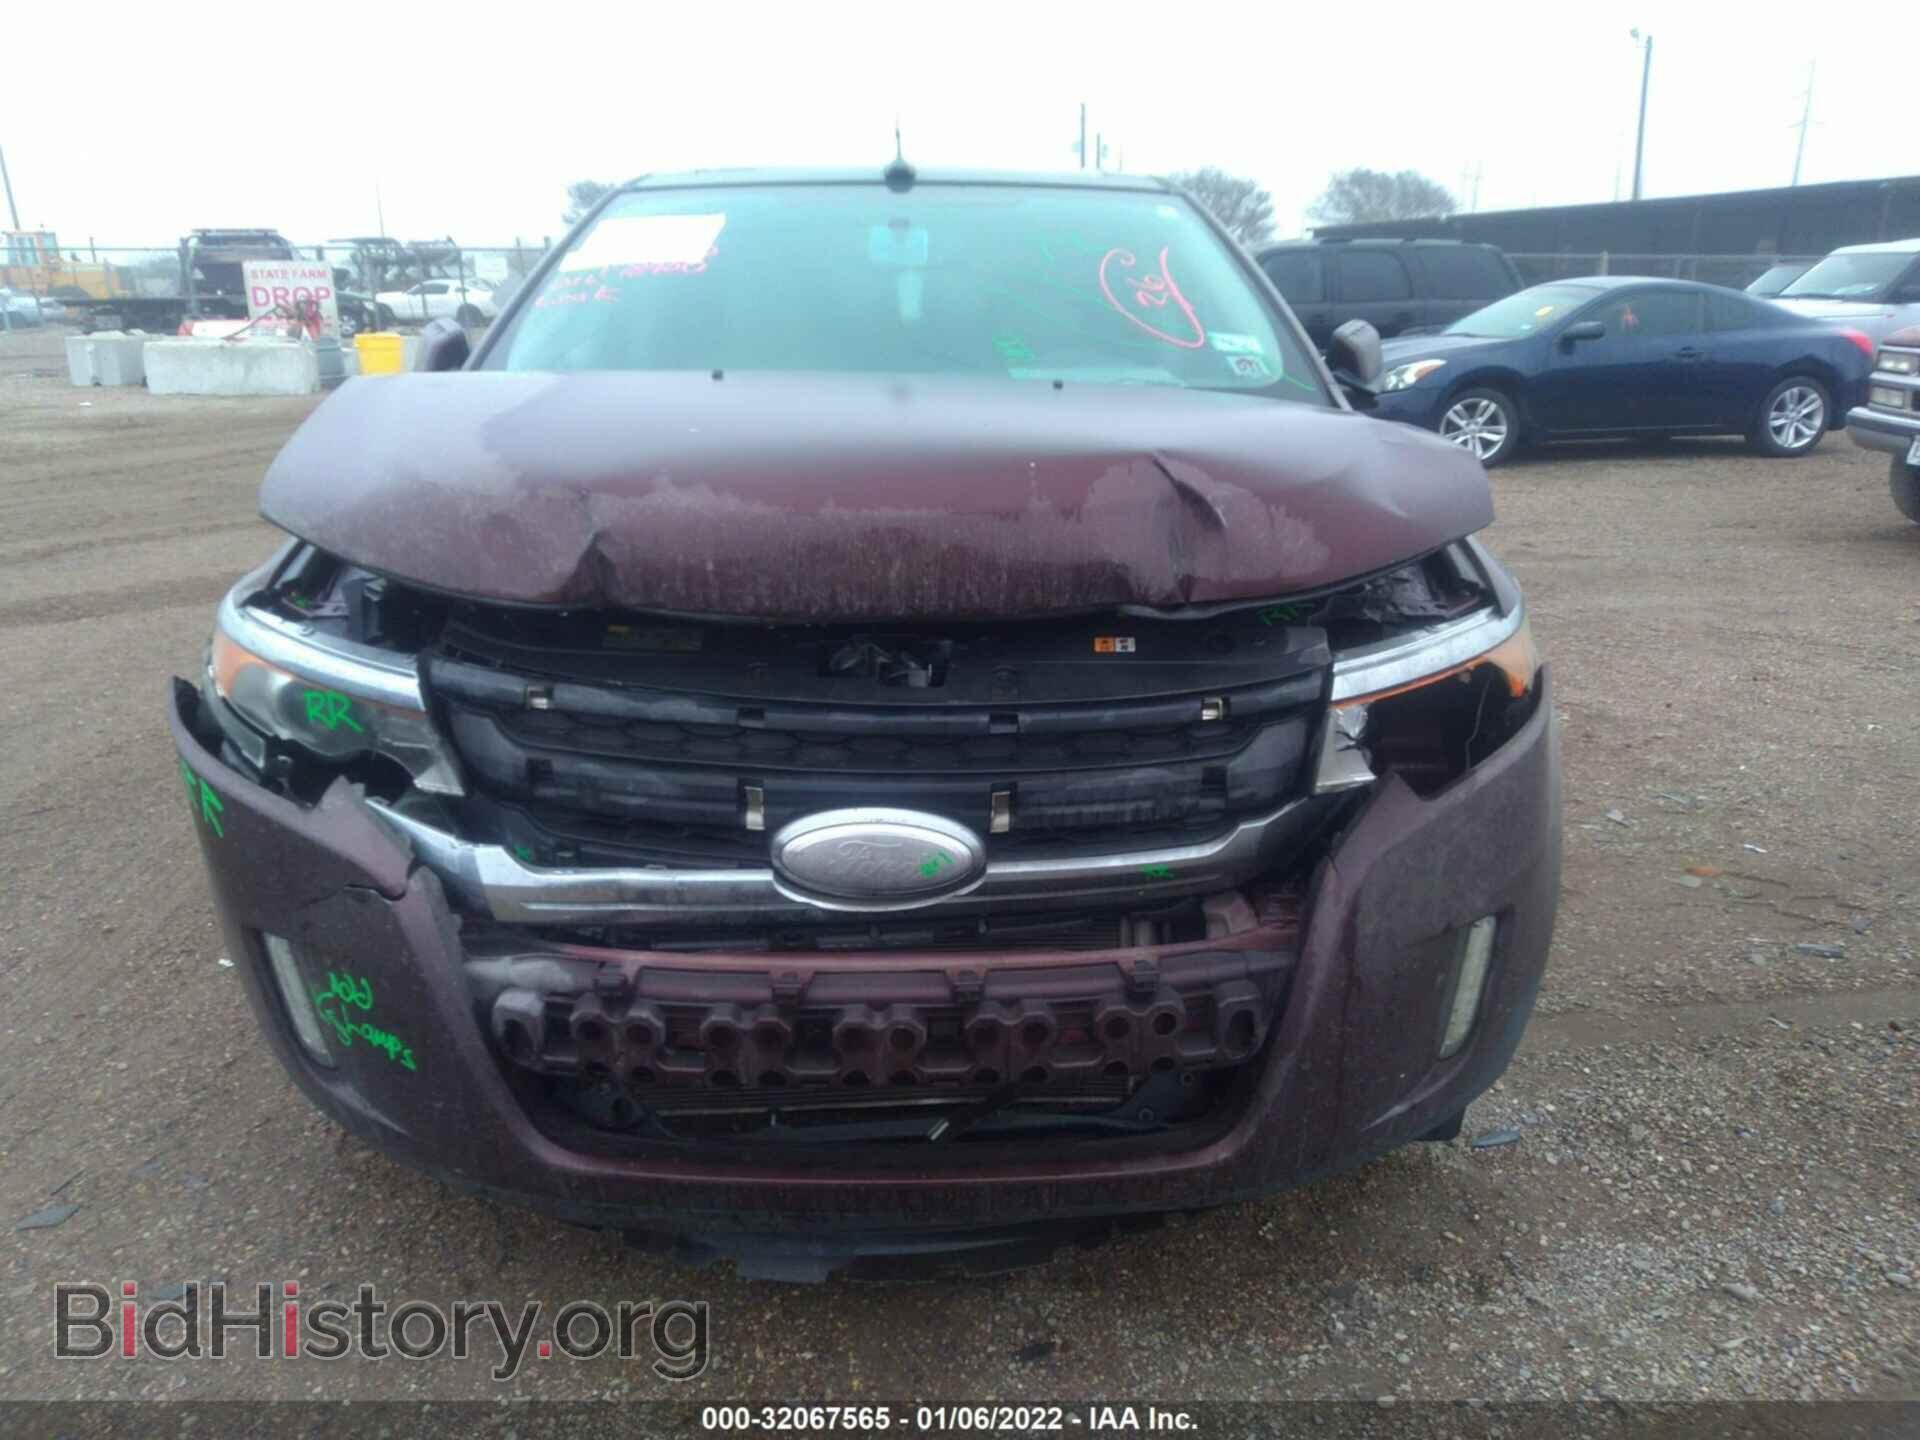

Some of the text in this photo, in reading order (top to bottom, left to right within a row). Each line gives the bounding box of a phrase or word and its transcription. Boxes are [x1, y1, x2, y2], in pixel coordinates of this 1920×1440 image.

[251, 269, 327, 279] STATE FARM
[251, 286, 331, 307] DROP
[304, 689, 366, 735] RR
